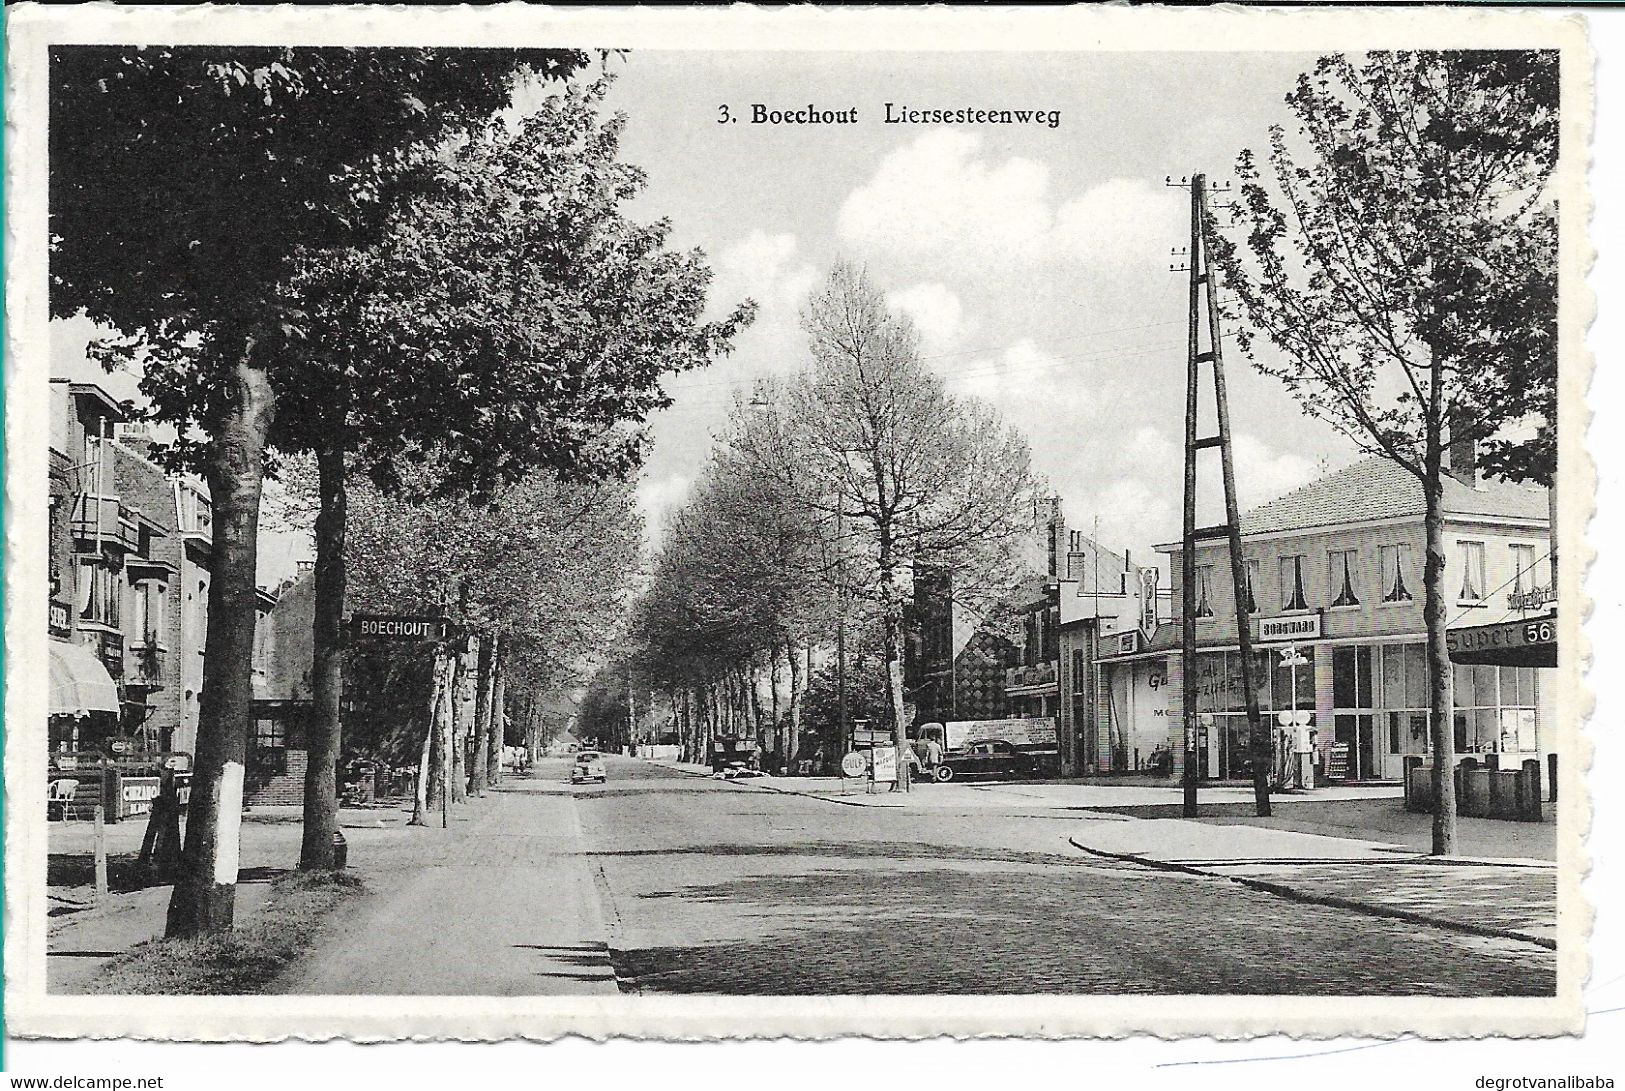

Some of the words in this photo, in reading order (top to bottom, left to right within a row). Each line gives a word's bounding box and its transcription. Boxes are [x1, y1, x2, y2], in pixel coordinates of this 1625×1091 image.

[1143, 569, 1153, 630] GULF
[361, 620, 430, 637] BOECHOUT
[440, 623, 447, 637] 1
[1263, 620, 1315, 636] BORGWARD
[1446, 628, 1513, 652] Super
[1527, 622, 1551, 643] 56
[843, 758, 863, 769] GULF
